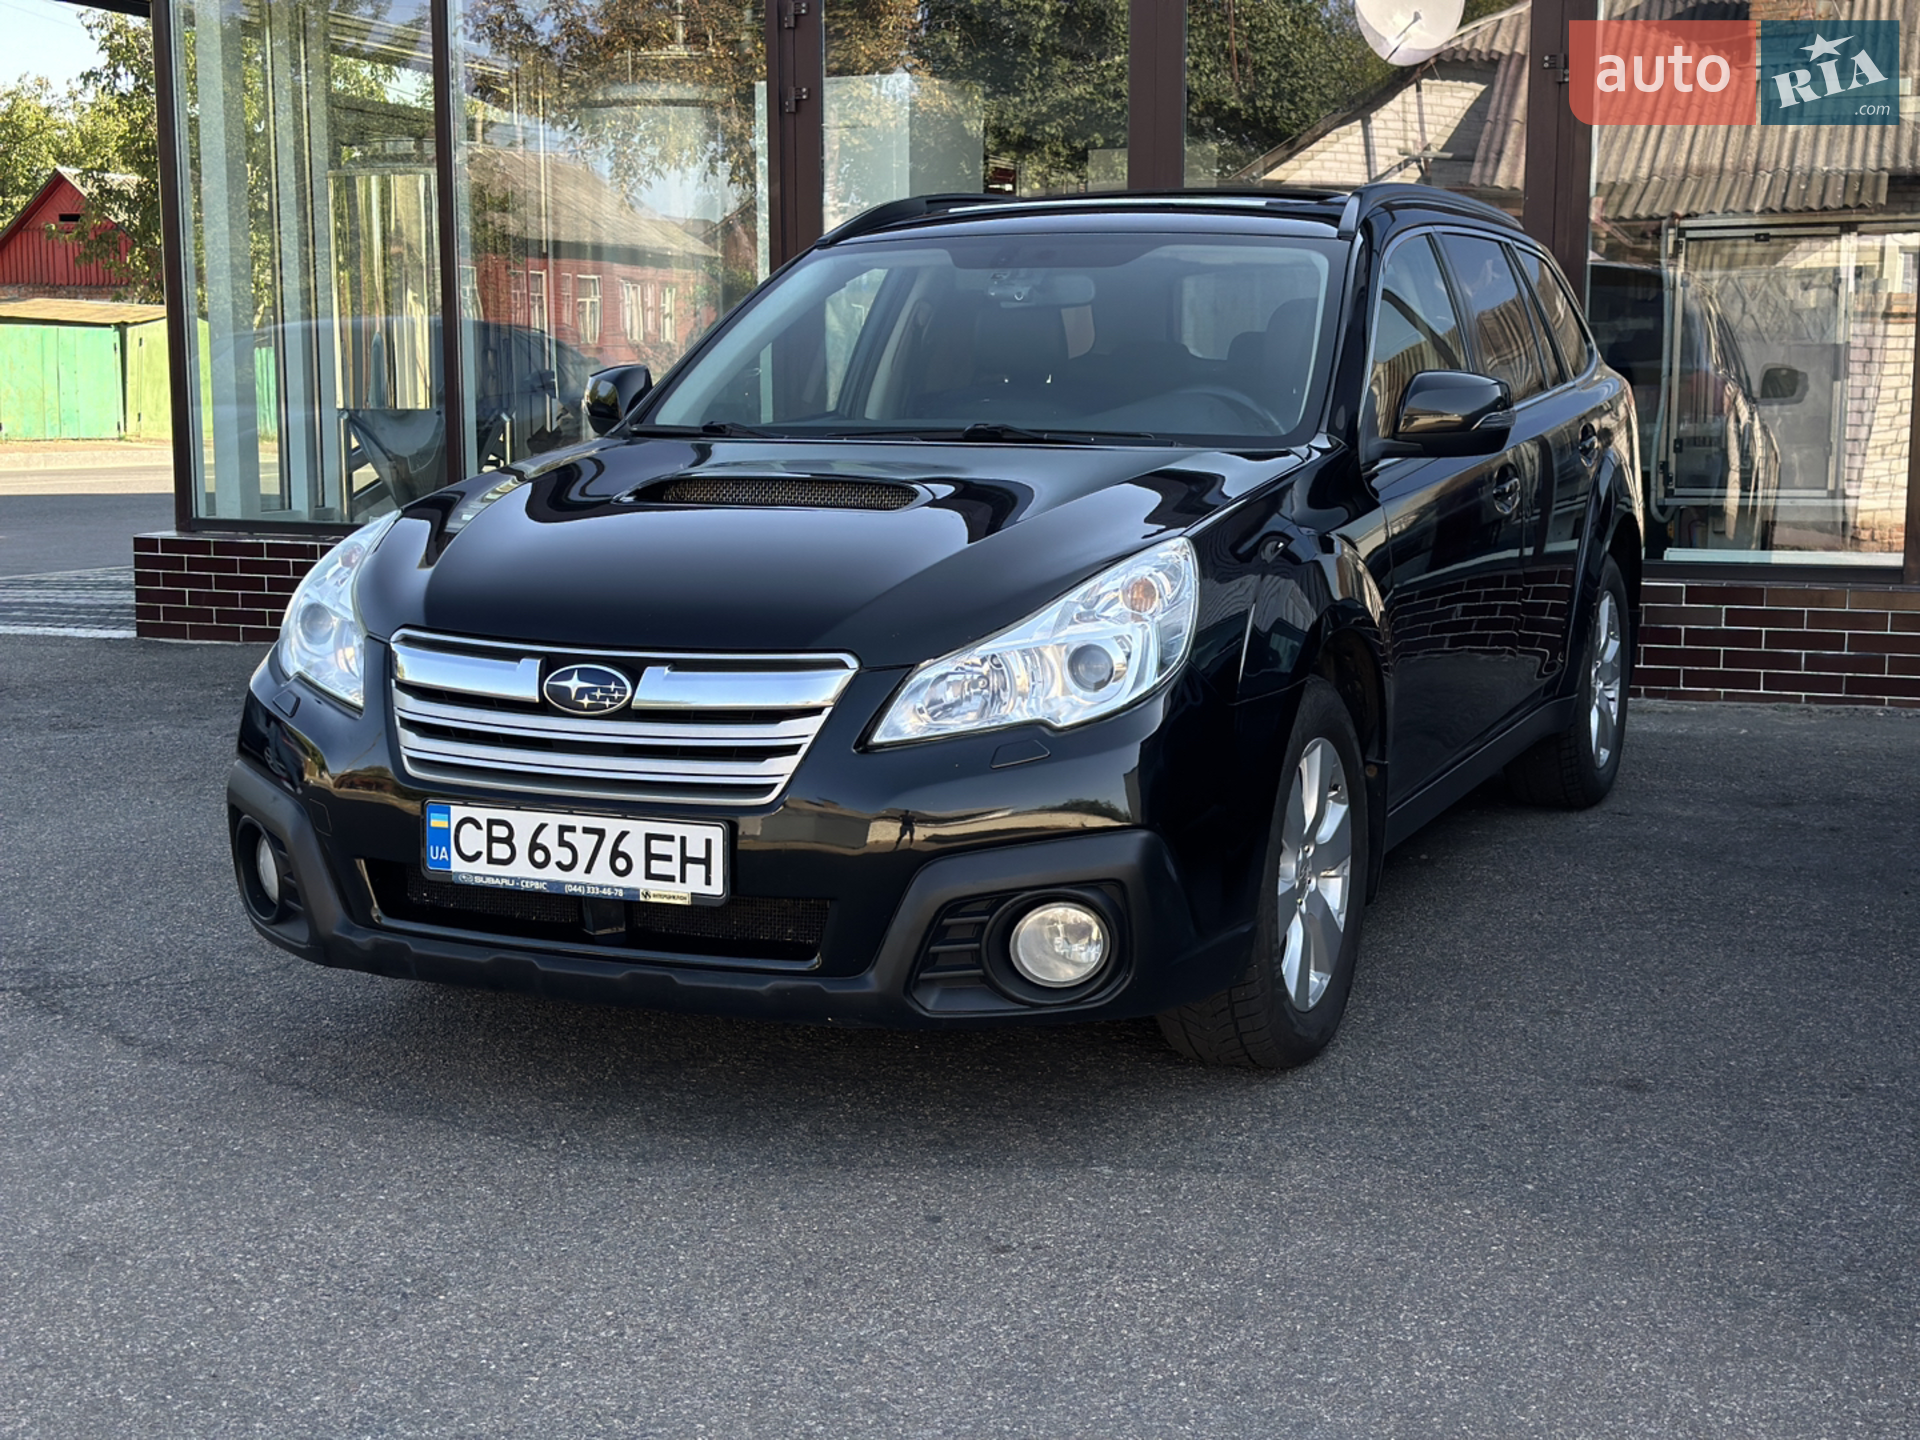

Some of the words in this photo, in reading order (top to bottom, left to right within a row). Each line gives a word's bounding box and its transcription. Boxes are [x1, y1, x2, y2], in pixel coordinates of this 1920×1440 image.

[429, 845, 449, 861] UA
[527, 822, 634, 878] 6576
[474, 876, 515, 886] SUBARU
[564, 883, 586, 895] (044)
